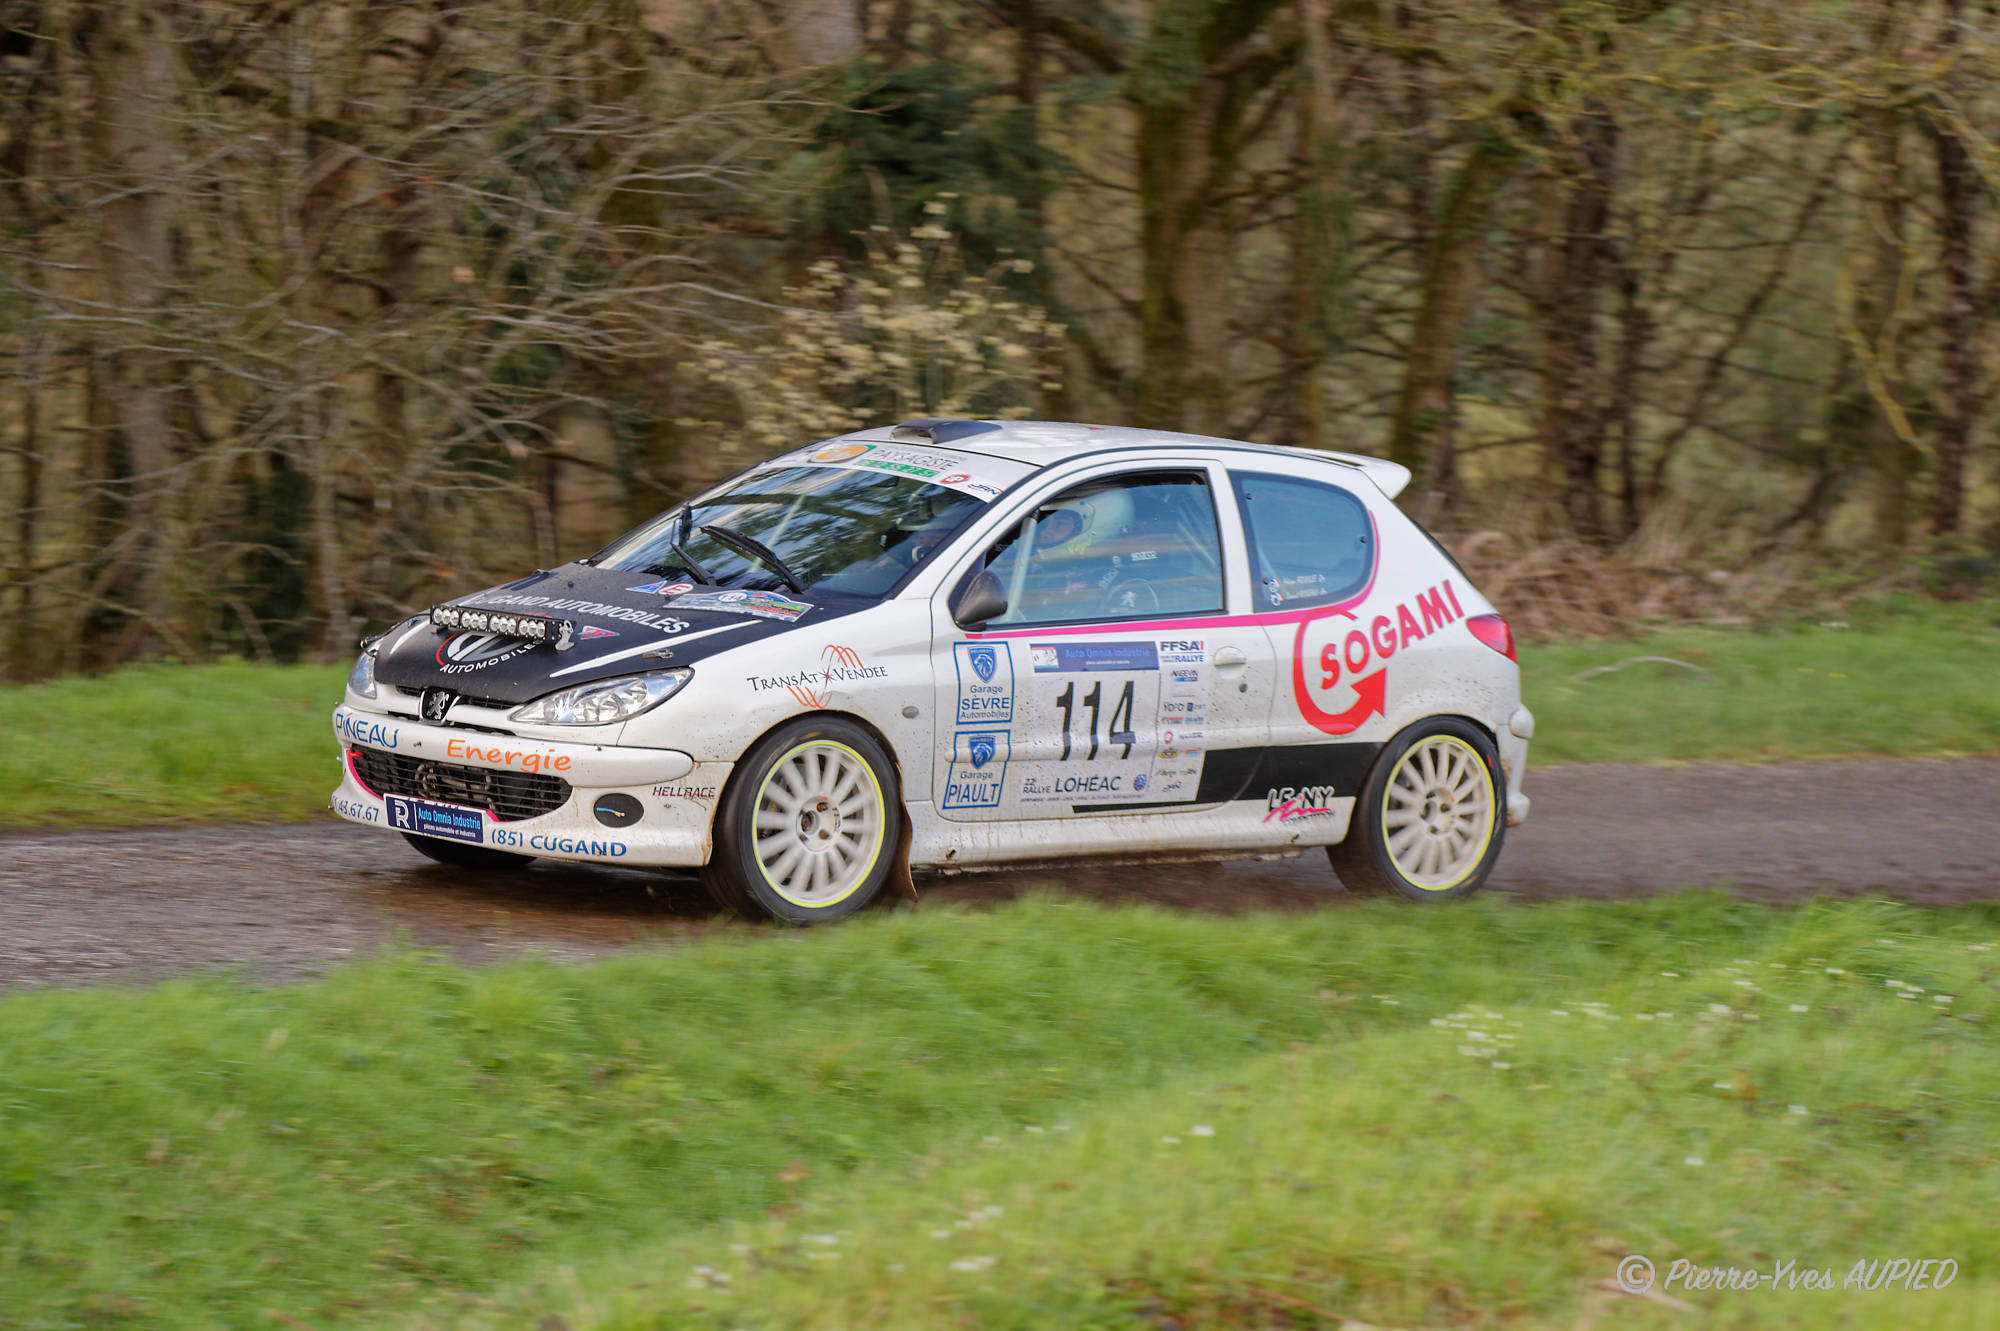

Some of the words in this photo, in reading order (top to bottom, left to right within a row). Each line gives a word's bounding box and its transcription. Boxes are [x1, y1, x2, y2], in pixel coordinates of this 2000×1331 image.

[537, 598, 690, 634] AUTOMOBILES
[1320, 579, 1464, 690] SOGAMI
[1065, 649, 1085, 659] Auto
[1087, 648, 1112, 658] Omnia
[1114, 647, 1150, 657] Industrie
[1160, 641, 1200, 652] FFSA
[970, 685, 1003, 696] Garage
[961, 695, 1010, 711] SÈVRE
[960, 709, 1009, 720] Automobiles
[1056, 681, 1136, 761] 114
[447, 738, 572, 774] Energie
[960, 770, 994, 781] Garage
[1022, 785, 1051, 794] RALLYE
[1055, 773, 1121, 793] LOHÉAC
[652, 786, 716, 798] HELLRACE
[947, 783, 1000, 803] PIAULT
[418, 807, 432, 822] Auto
[433, 809, 452, 826] Omnia
[453, 813, 481, 831] Industrie
[530, 834, 627, 857] CUGAND
